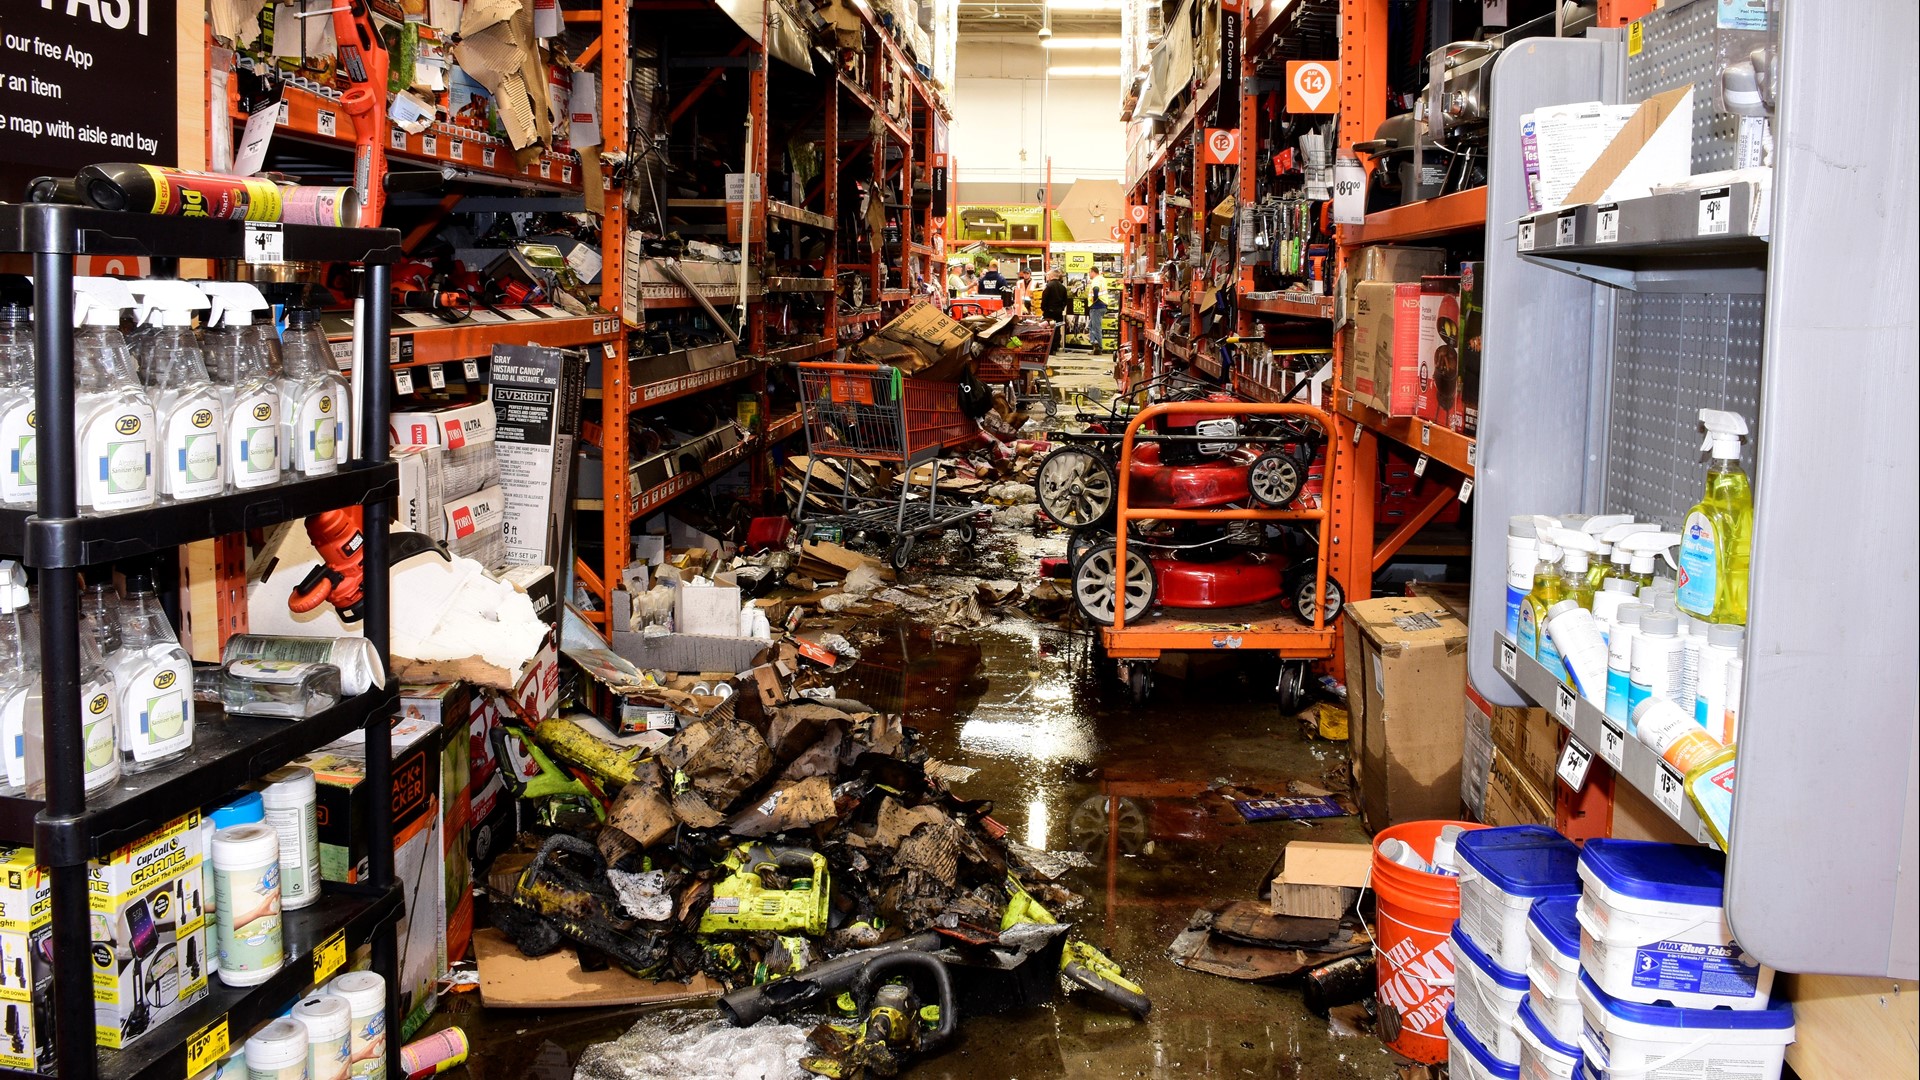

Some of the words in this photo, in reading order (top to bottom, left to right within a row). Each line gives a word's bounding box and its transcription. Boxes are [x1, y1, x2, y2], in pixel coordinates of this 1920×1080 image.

[41, 0, 148, 36] AST
[6, 34, 31, 52] our
[34, 36, 62, 60] free
[65, 44, 93, 70] App
[1226, 40, 1234, 80] Covers
[8, 75, 27, 92] an
[31, 75, 62, 98] item
[1303, 77, 1323, 91] 14
[10, 115, 42, 138] map
[46, 119, 75, 140] with
[78, 124, 107, 145] aisle
[110, 131, 134, 148] and
[137, 132, 158, 156] bay
[1215, 139, 1229, 149] 12
[1525, 151, 1538, 161] Tes
[159, 180, 169, 196] SIZE
[218, 191, 229, 218] Roach
[494, 355, 511, 364] GRAY
[493, 364, 518, 374] INSTANT
[520, 367, 545, 376] CANOPY
[493, 373, 509, 381] TOLDO
[509, 374, 516, 382] AL
[516, 375, 540, 384] INSTANTE
[544, 377, 557, 385] GRIS
[497, 389, 549, 402] EVERBILT
[121, 418, 139, 431] Zep
[196, 412, 211, 424] Zep
[464, 418, 481, 431] ULTRA
[448, 429, 462, 441] TORO
[473, 502, 490, 517] ULTRA
[455, 515, 472, 530] TORO
[503, 522, 510, 535] 8
[511, 526, 517, 535] ft
[505, 536, 517, 545] 2.43
[519, 551, 529, 560] SET
[156, 672, 175, 688] Zep
[392, 765, 420, 795] ACK+
[392, 781, 421, 812] CKER
[137, 853, 152, 866] Cup
[153, 843, 169, 858] Call
[131, 847, 186, 886] CRANE
[126, 887, 138, 898] You
[139, 876, 160, 892] Choose
[161, 869, 171, 880] The
[172, 859, 194, 873] Height!
[35, 887, 50, 899] Cup
[0, 920, 16, 928] ght!
[1385, 936, 1421, 971] THE
[1707, 945, 1732, 957] Tabs
[1642, 957, 1652, 971] 3
[1380, 937, 1455, 1015] HOM
[1406, 988, 1455, 1032] DEP
